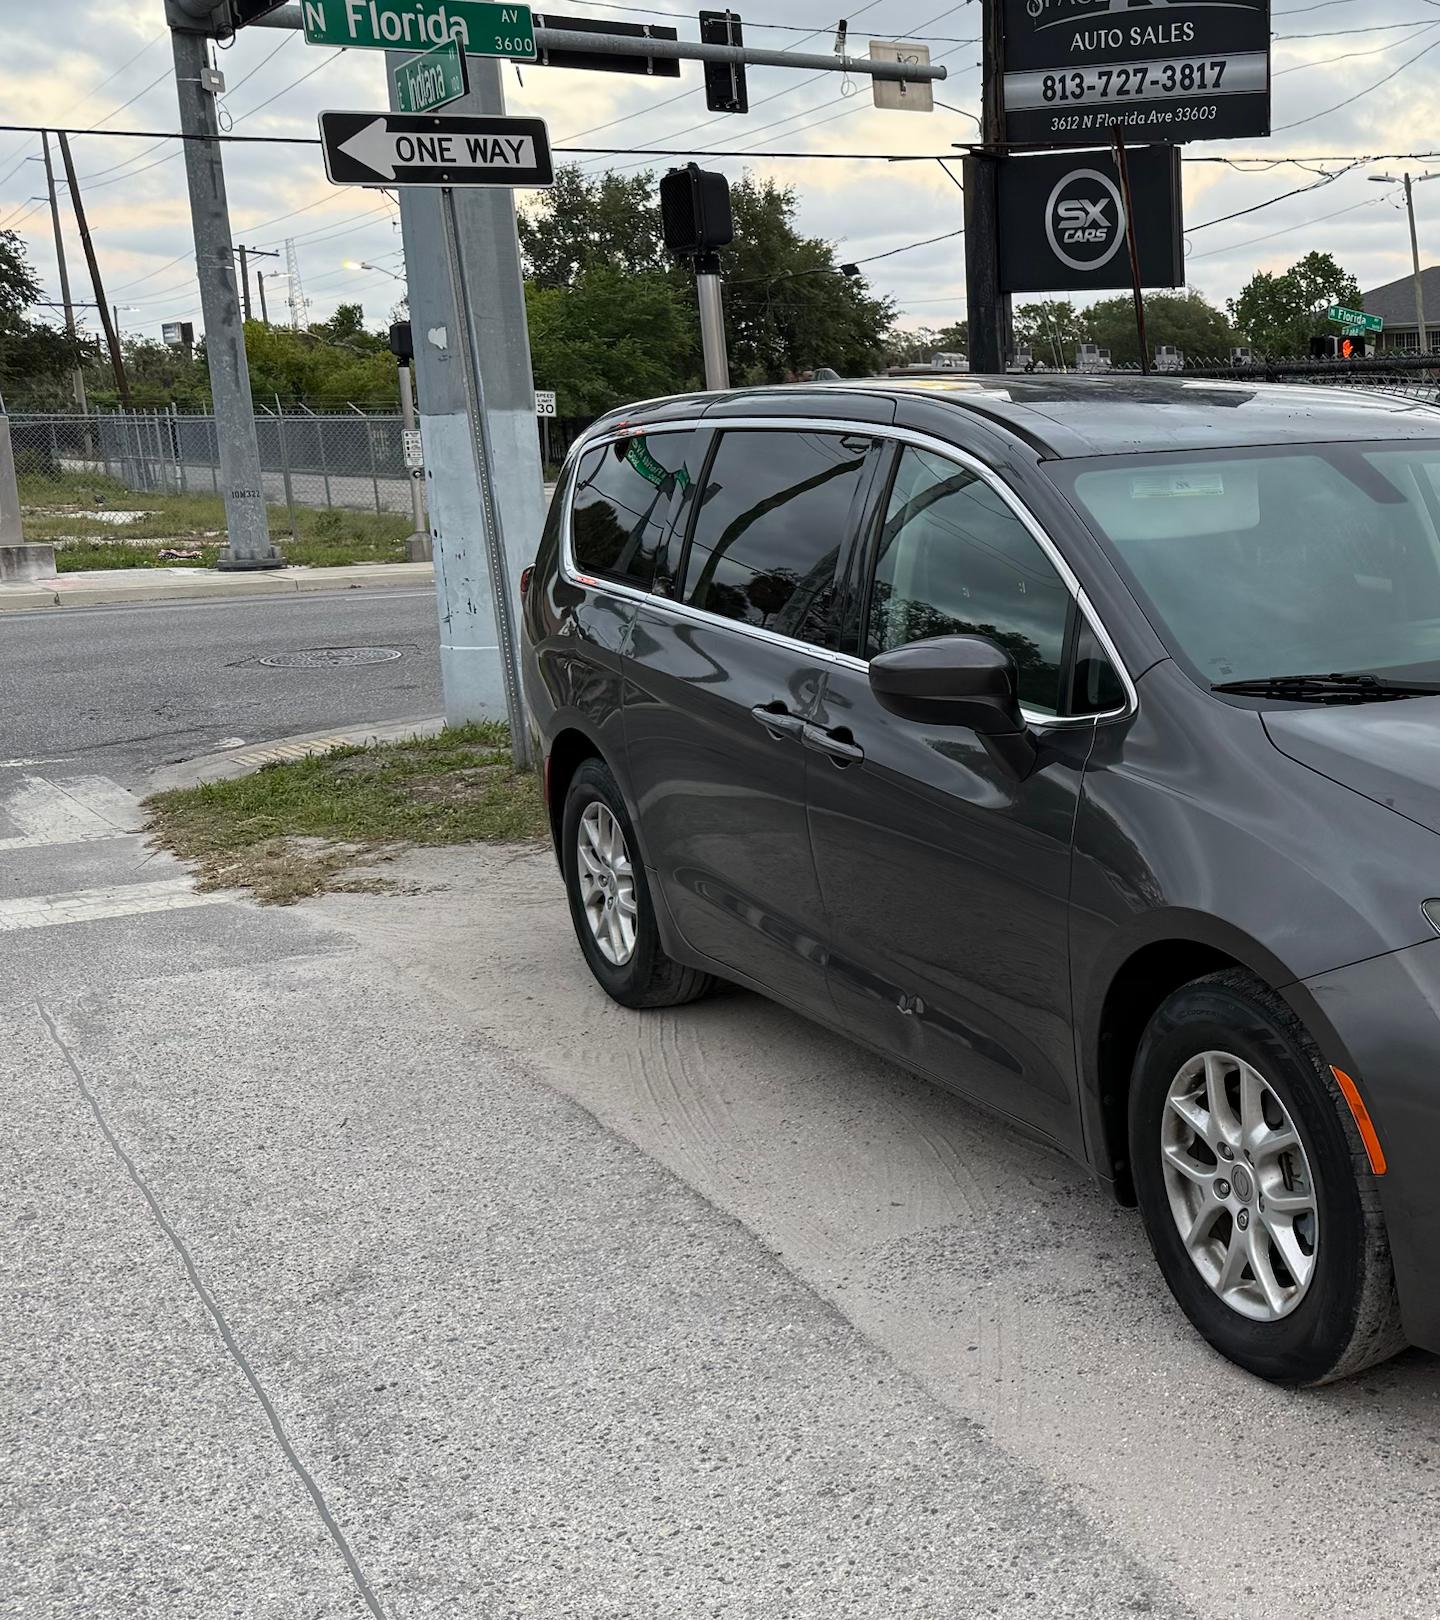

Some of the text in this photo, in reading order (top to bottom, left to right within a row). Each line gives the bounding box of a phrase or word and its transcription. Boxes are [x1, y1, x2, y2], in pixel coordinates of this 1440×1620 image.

[304, 0, 518, 45] N Florida AV
[1070, 21, 1195, 51] AUTO SALES
[494, 36, 533, 52] 3600
[406, 62, 445, 112] Indiana
[1042, 60, 1227, 102] 813-727-3817
[1051, 105, 1217, 131] 3612 N Florida Ave 33603
[395, 136, 525, 165] ONE WAY
[1057, 197, 1112, 229] SX
[1063, 228, 1108, 244] CARS
[1338, 309, 1366, 324] Florida
[537, 403, 553, 413] 30
